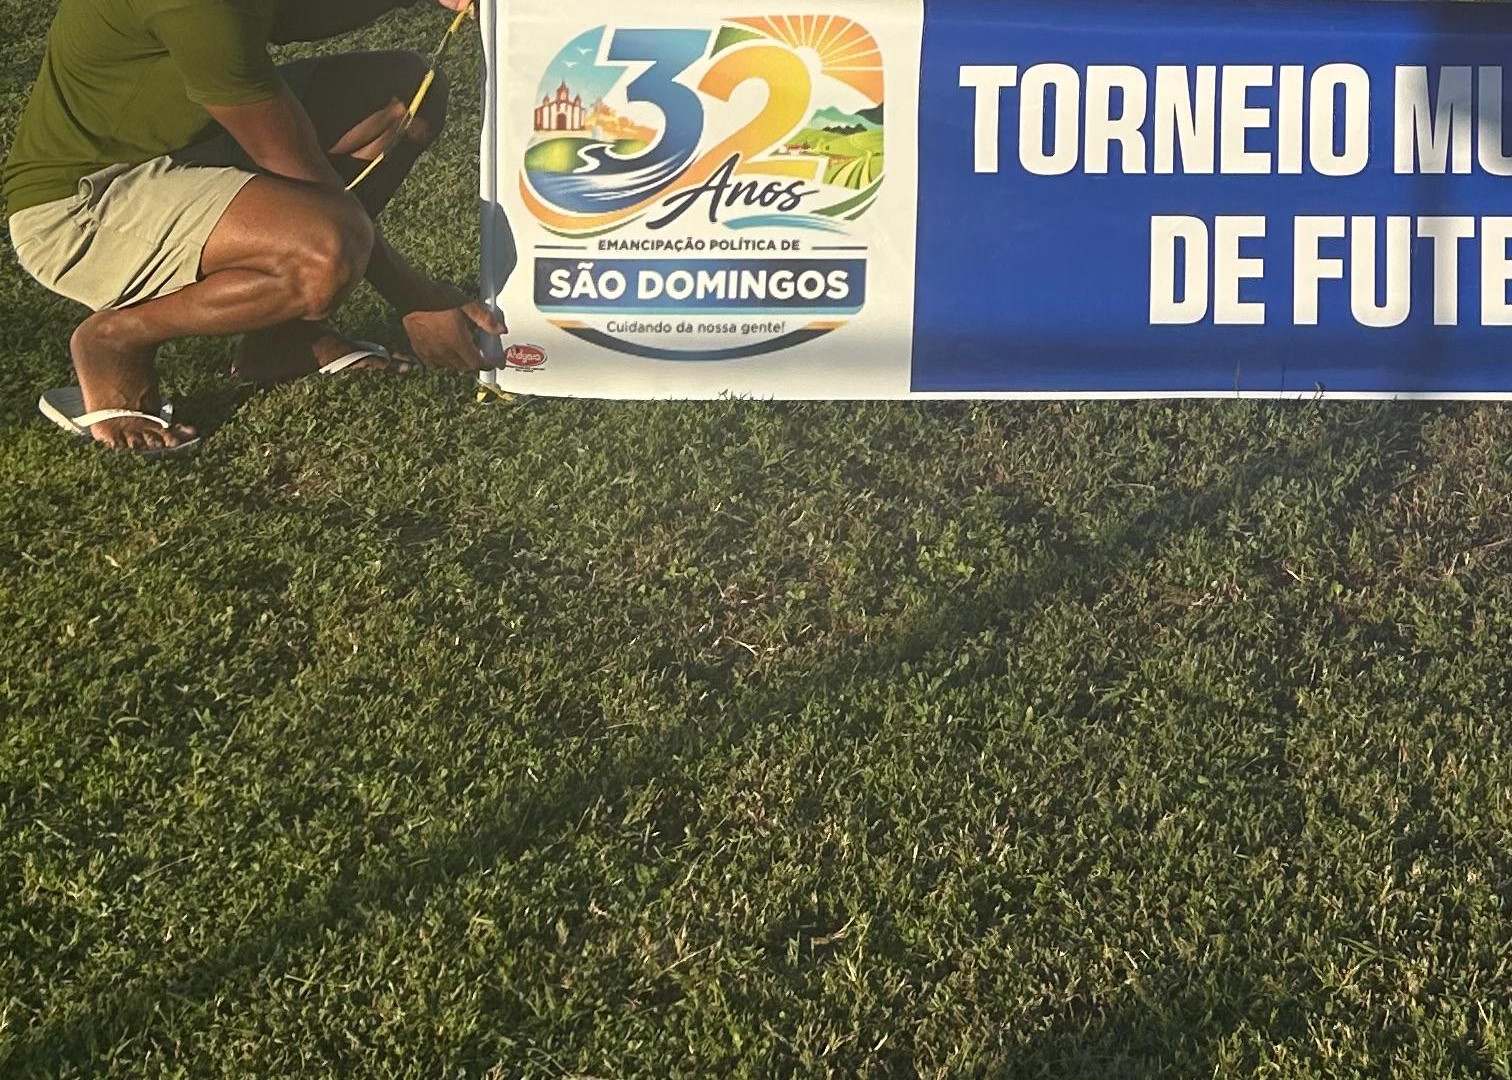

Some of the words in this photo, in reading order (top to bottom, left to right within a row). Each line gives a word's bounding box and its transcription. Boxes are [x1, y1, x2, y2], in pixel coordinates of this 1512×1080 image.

[958, 63, 1371, 177] TORNEIO
[645, 152, 821, 230] Anos
[597, 236, 706, 253] EMANCIPAÇÃO
[709, 236, 776, 251] POLÍTICA
[780, 239, 801, 251] DE
[1147, 213, 1266, 328] DE
[548, 262, 627, 300] SÃO
[637, 269, 850, 300] DOMINGOS
[606, 320, 672, 334] Cuidando
[677, 320, 694, 334] da
[697, 323, 738, 334] nossa
[740, 321, 786, 335] gente!
